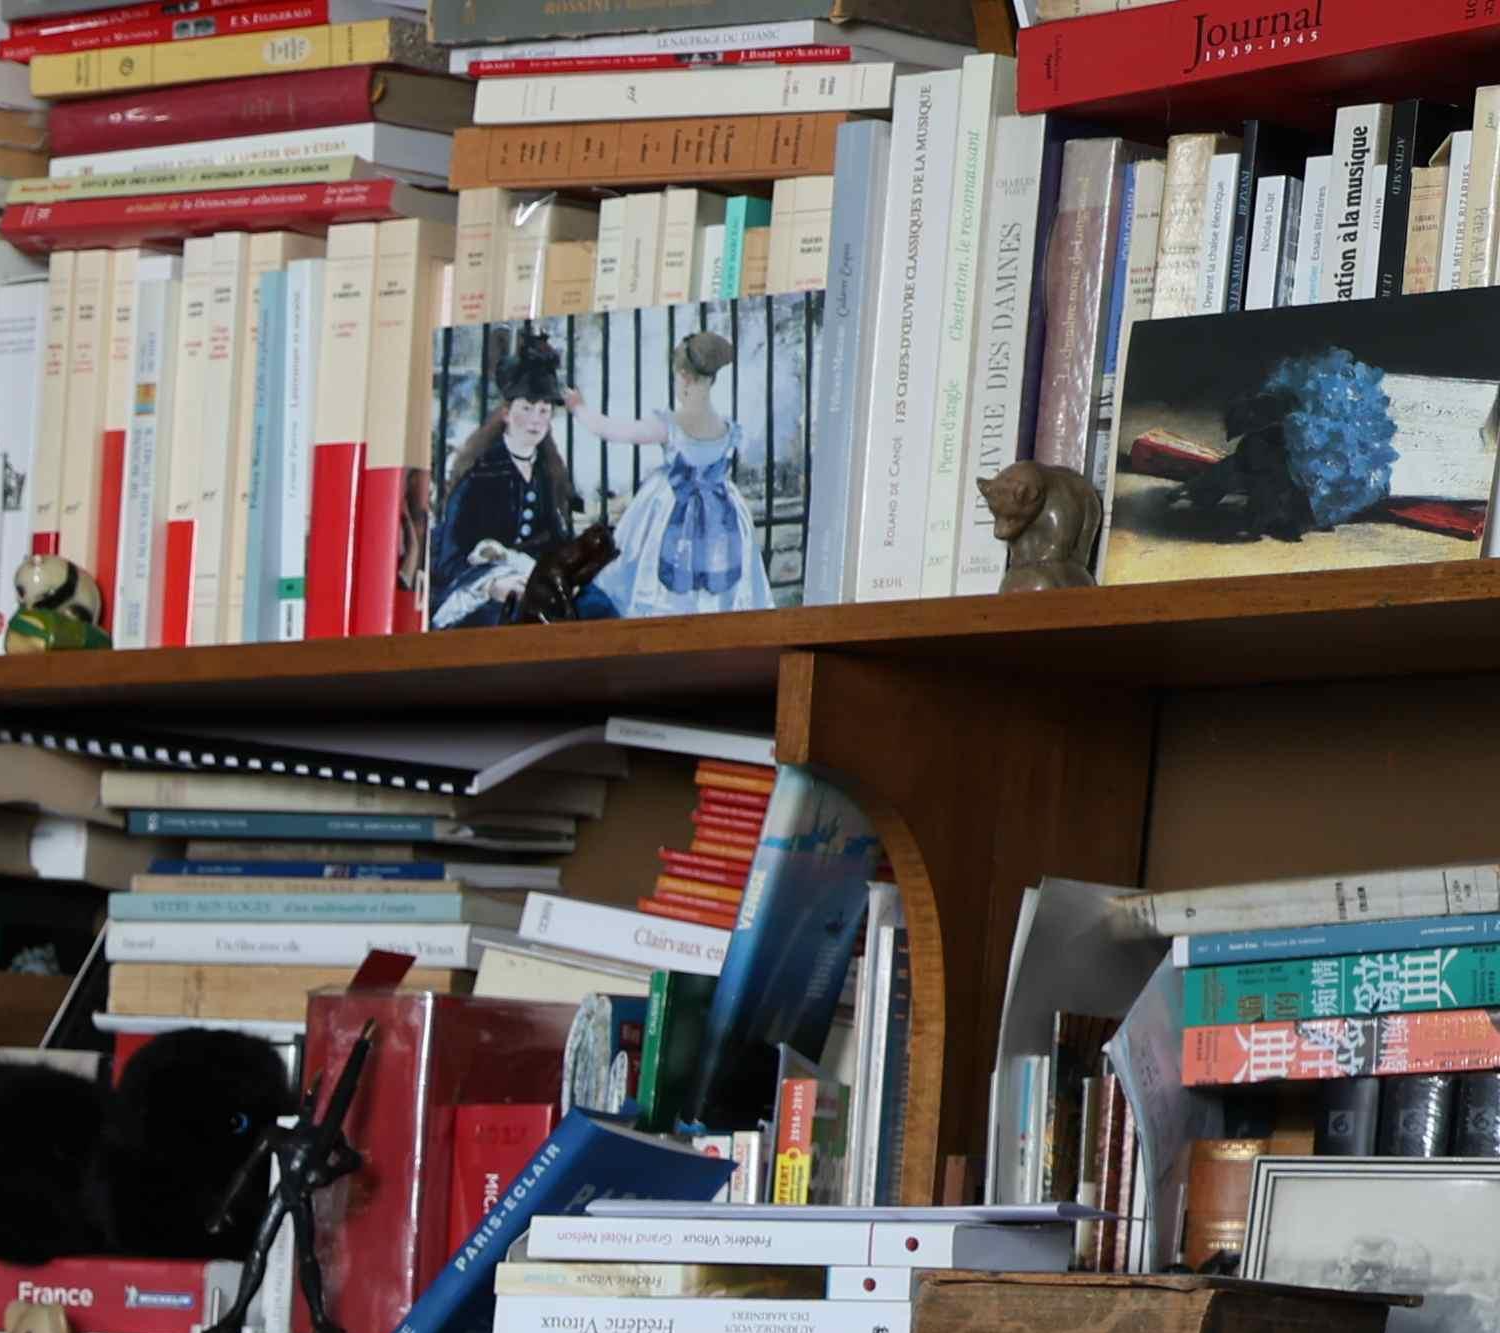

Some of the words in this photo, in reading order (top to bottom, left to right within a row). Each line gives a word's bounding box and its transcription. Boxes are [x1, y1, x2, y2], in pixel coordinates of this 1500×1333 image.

[1183, 0, 1324, 74] Journal
[1203, 30, 1320, 63] 1939-1945
[914, 84, 933, 152] MUSIQUE
[913, 152, 927, 174] LA
[1338, 125, 1370, 208] musique
[910, 175, 925, 195] DE
[957, 129, 981, 237] reconnaissant
[1211, 180, 1226, 230] électrique
[1336, 209, 1361, 230] la
[904, 197, 923, 283] CLASSIQUES
[1207, 230, 1221, 262] chaise
[1259, 213, 1274, 252] Nicolas
[1311, 231, 1323, 262] Essais
[1201, 273, 1217, 310] Devant
[985, 340, 1011, 390] DES
[936, 437, 958, 475] Pierre
[740, 871, 767, 930] VENISE
[556, 1229, 598, 1244] Nelson
[600, 1229, 633, 1246] Hôtel
[634, 1229, 673, 1245] Grand
[681, 1230, 722, 1246] Vitoux
[721, 1231, 773, 1248] Frédéric
[17, 1281, 94, 1307] France
[575, 1272, 615, 1288] Vitoux
[613, 1273, 664, 1290] Frédéric
